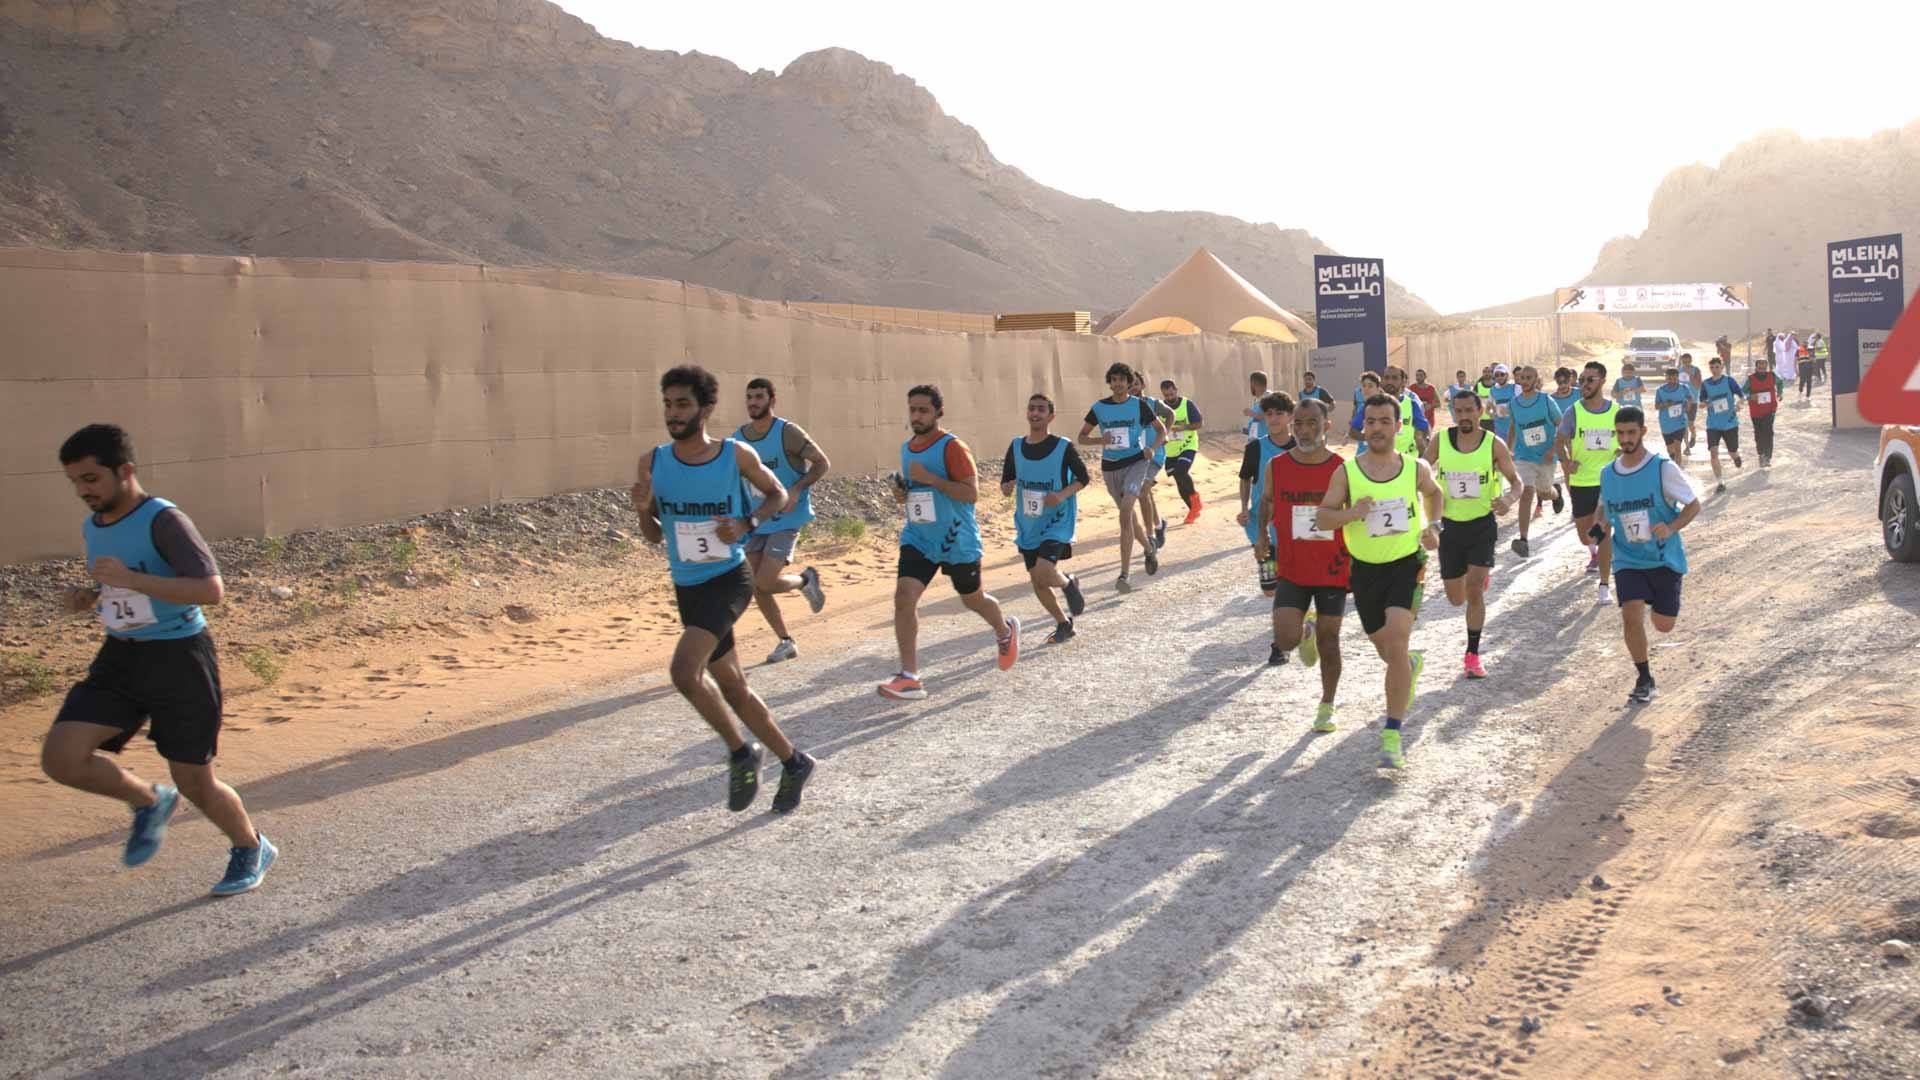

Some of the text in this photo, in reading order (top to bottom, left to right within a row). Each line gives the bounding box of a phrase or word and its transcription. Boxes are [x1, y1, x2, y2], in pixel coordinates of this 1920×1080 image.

[1831, 244, 1899, 265] MLEIHA
[1318, 263, 1380, 283] MLEIHA
[1530, 433, 1541, 442] 10
[1595, 437, 1602, 445] 4
[1458, 481, 1467, 493] 3
[660, 495, 732, 516] hummel
[914, 503, 922, 517] 8
[1028, 500, 1038, 511] 19
[1608, 493, 1655, 513] hummel
[1383, 513, 1393, 527] 2
[1627, 523, 1640, 536] 17
[696, 537, 709, 553] 3
[112, 601, 135, 620] 24
